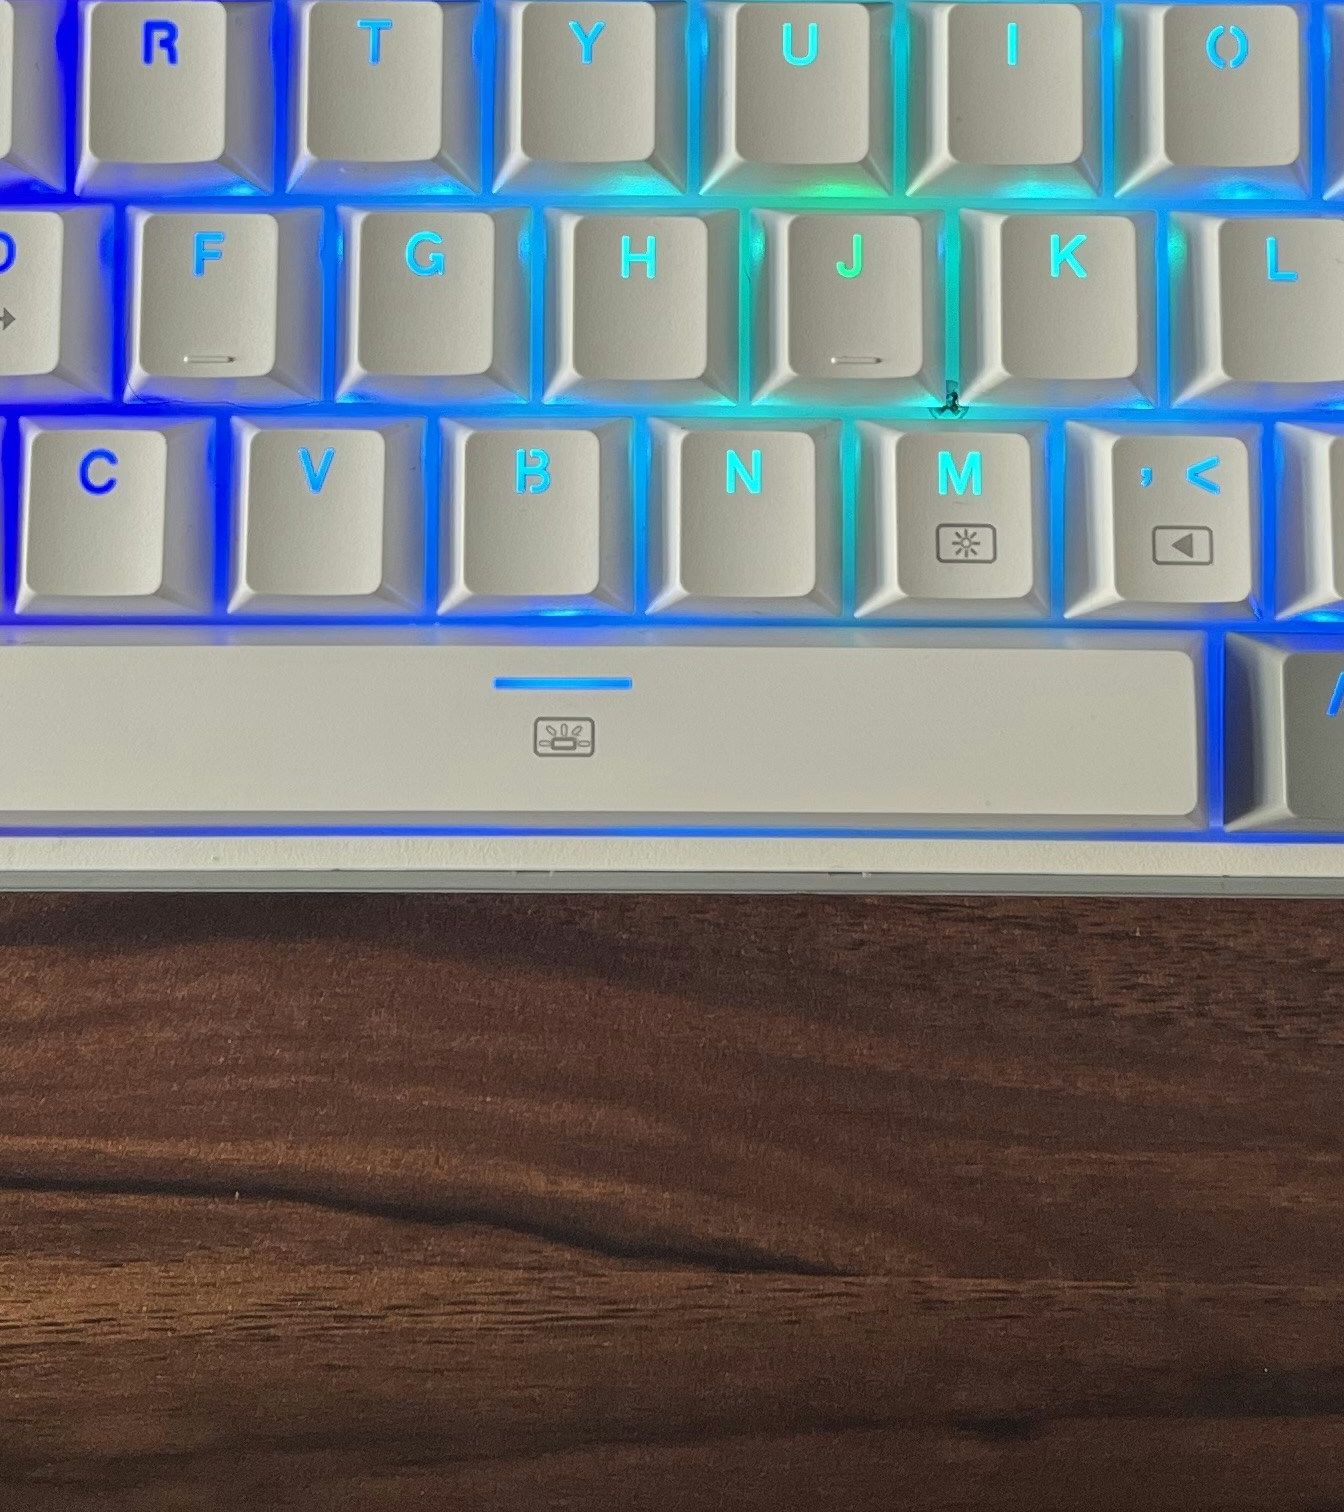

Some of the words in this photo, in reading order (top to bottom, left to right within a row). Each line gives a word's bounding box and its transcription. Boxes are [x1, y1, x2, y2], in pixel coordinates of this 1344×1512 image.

[142, 19, 179, 65] R
[356, 18, 393, 64] T
[568, 20, 606, 65] Y
[782, 22, 819, 66] U
[1206, 25, 1249, 69] O
[193, 231, 225, 277] F
[405, 231, 445, 277] G
[621, 234, 656, 279] H
[836, 234, 863, 278] J
[1050, 233, 1087, 279] K
[1266, 236, 1299, 283] L
[79, 448, 118, 496] C
[297, 447, 335, 494] V
[515, 448, 551, 494] B
[726, 449, 762, 494] N
[938, 451, 982, 496] M
